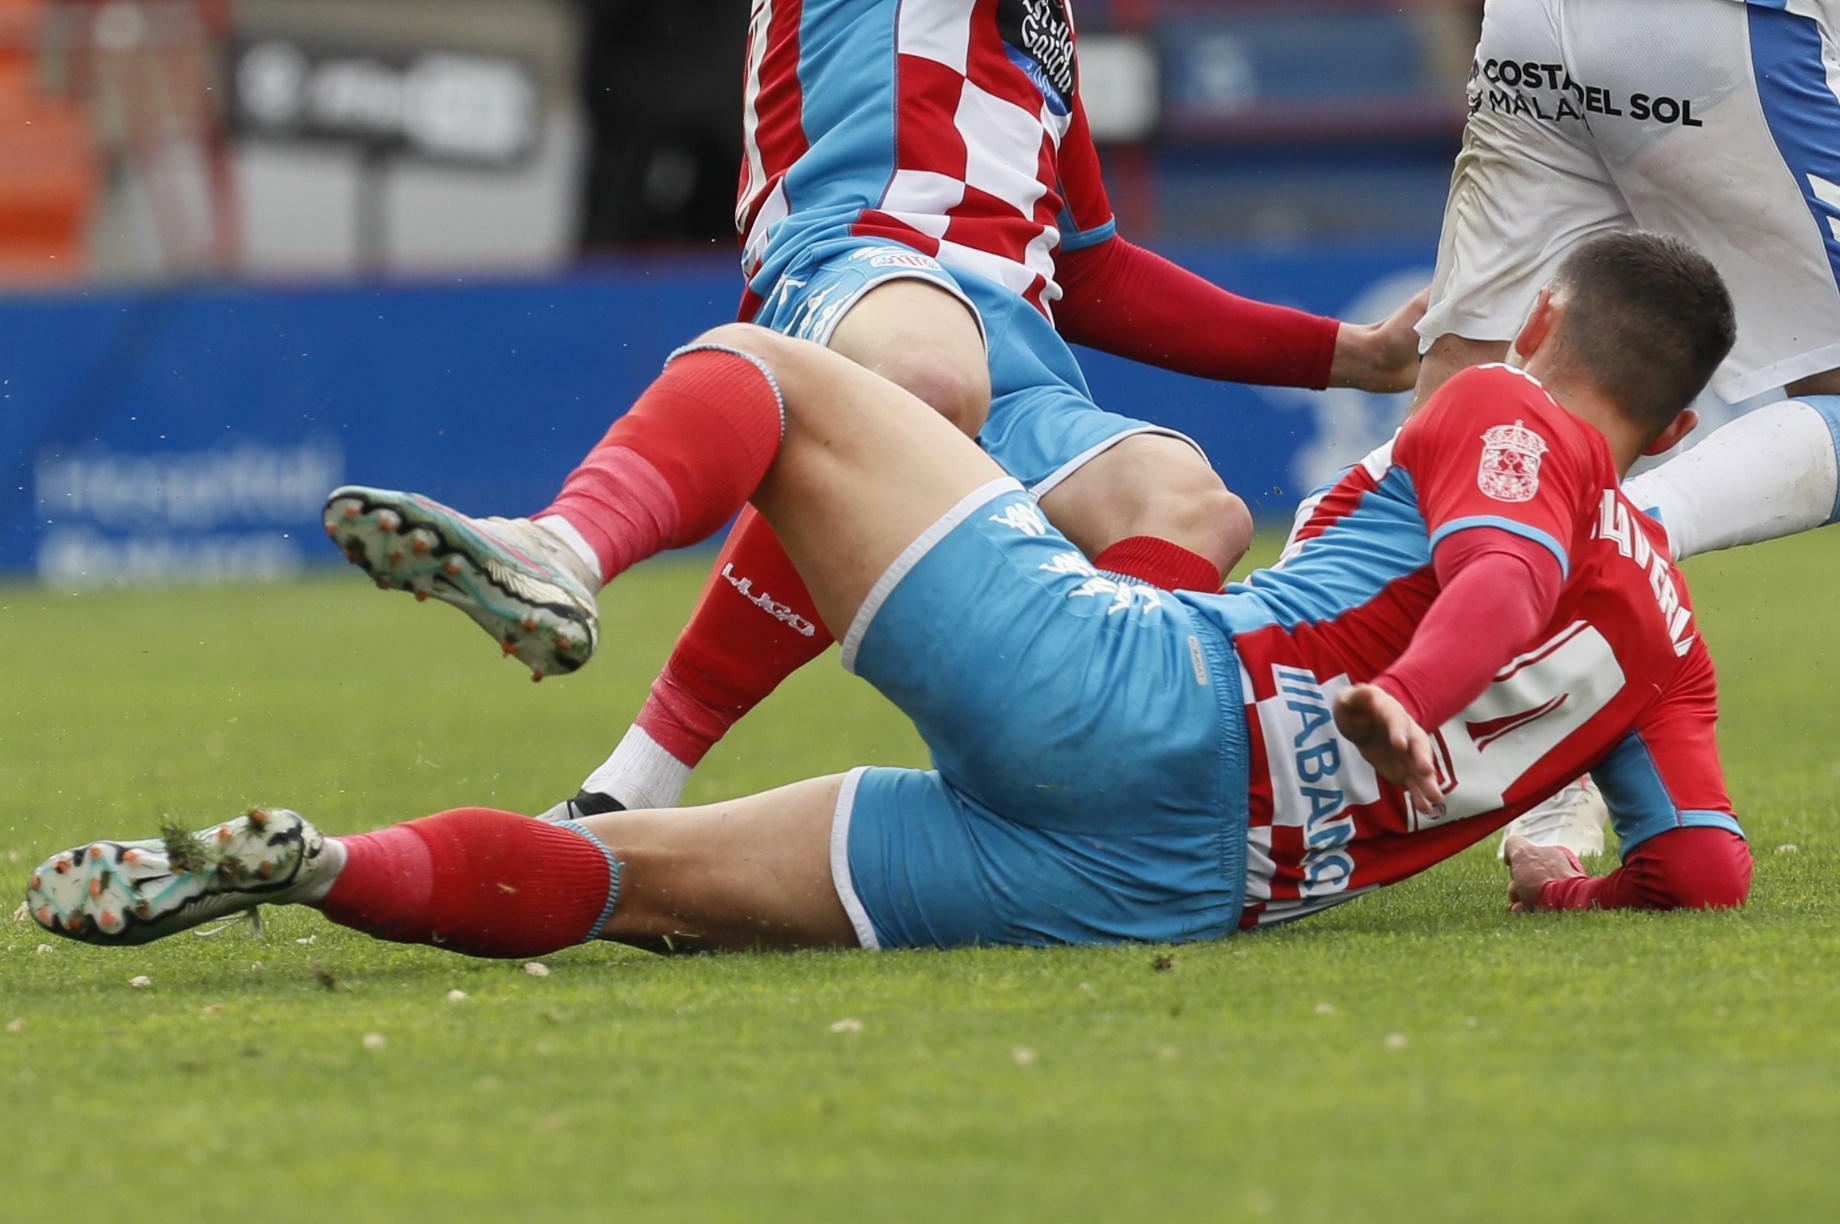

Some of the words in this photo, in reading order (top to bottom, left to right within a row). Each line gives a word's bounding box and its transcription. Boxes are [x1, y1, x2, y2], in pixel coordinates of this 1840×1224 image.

[1021, 15, 1072, 93] Galicia
[1489, 89, 1590, 128] MÁLA
[1630, 92, 1703, 127] SOL
[1590, 488, 1697, 658] LAVERI
